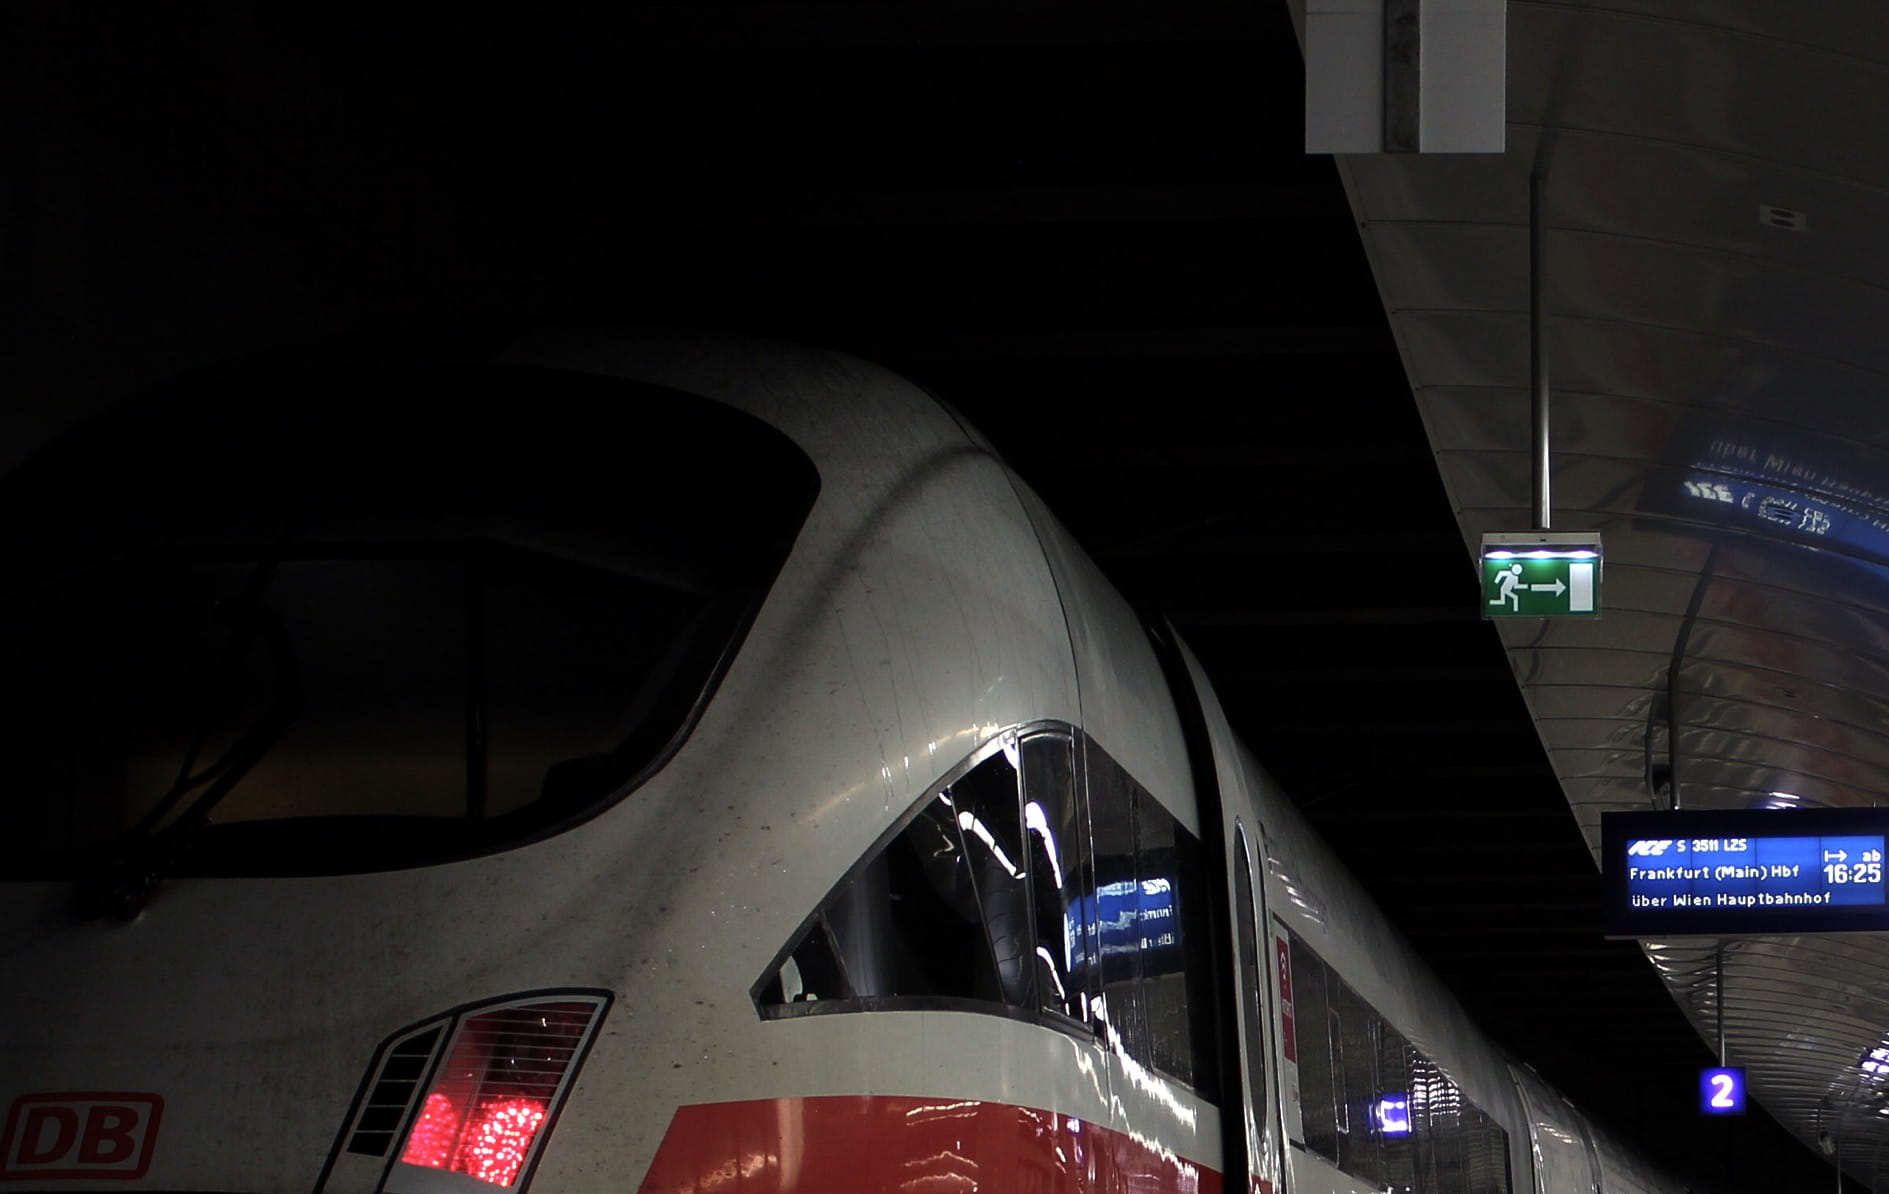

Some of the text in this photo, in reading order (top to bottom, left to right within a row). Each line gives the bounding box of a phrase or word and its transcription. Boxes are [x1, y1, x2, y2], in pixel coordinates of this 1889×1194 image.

[1862, 849, 1881, 862] ab
[1630, 865, 1799, 881] Frankfurt (Main) Hbf
[1823, 863, 1881, 884] 16:25
[1632, 891, 1831, 908] über Wien Hauptbahnhof
[1711, 1074, 1734, 1107] 2
[15, 1105, 139, 1165] DB
